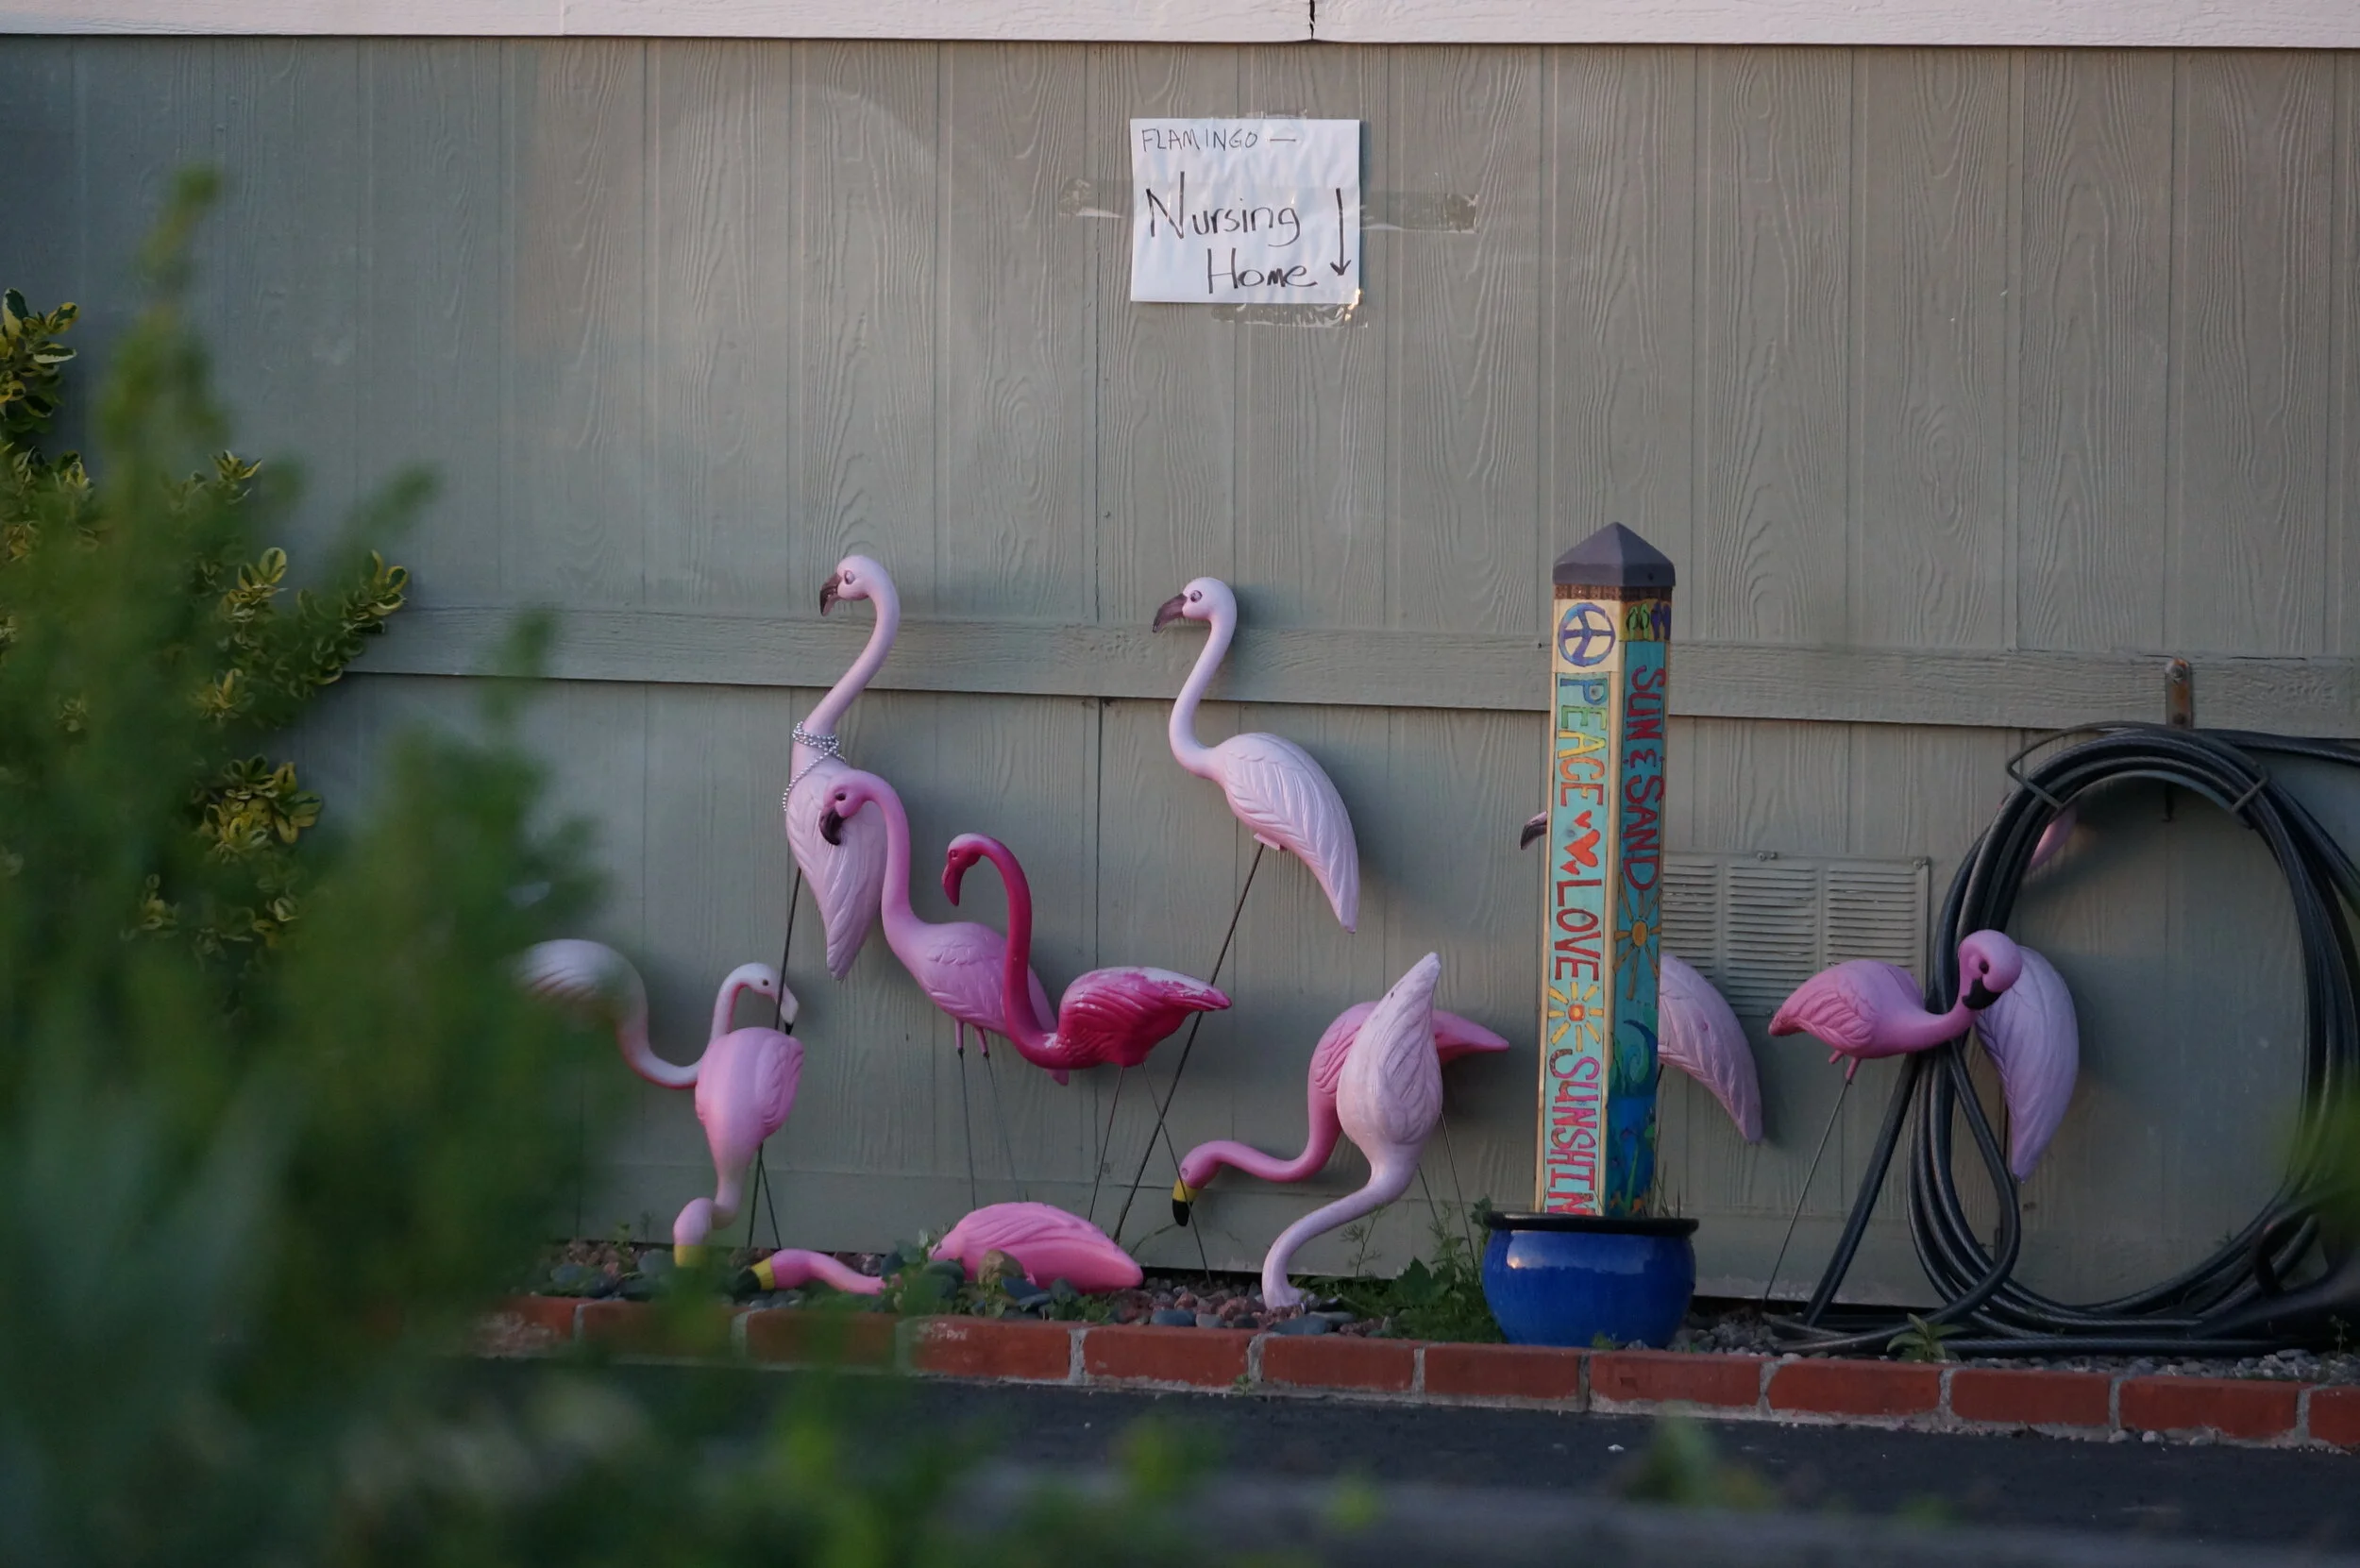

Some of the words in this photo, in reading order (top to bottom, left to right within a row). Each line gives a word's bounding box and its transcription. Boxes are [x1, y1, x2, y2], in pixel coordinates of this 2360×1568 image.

[1141, 128, 1258, 151] FLAMINGO
[1145, 171, 1301, 247] Nursing
[1206, 247, 1318, 294] Home
[1559, 678, 1607, 806] PEACE
[1626, 665, 1666, 742] SUN
[1622, 774, 1664, 890] SAND
[1554, 879, 1602, 982] LOVE
[1546, 1049, 1600, 1215] SUNSHIN
